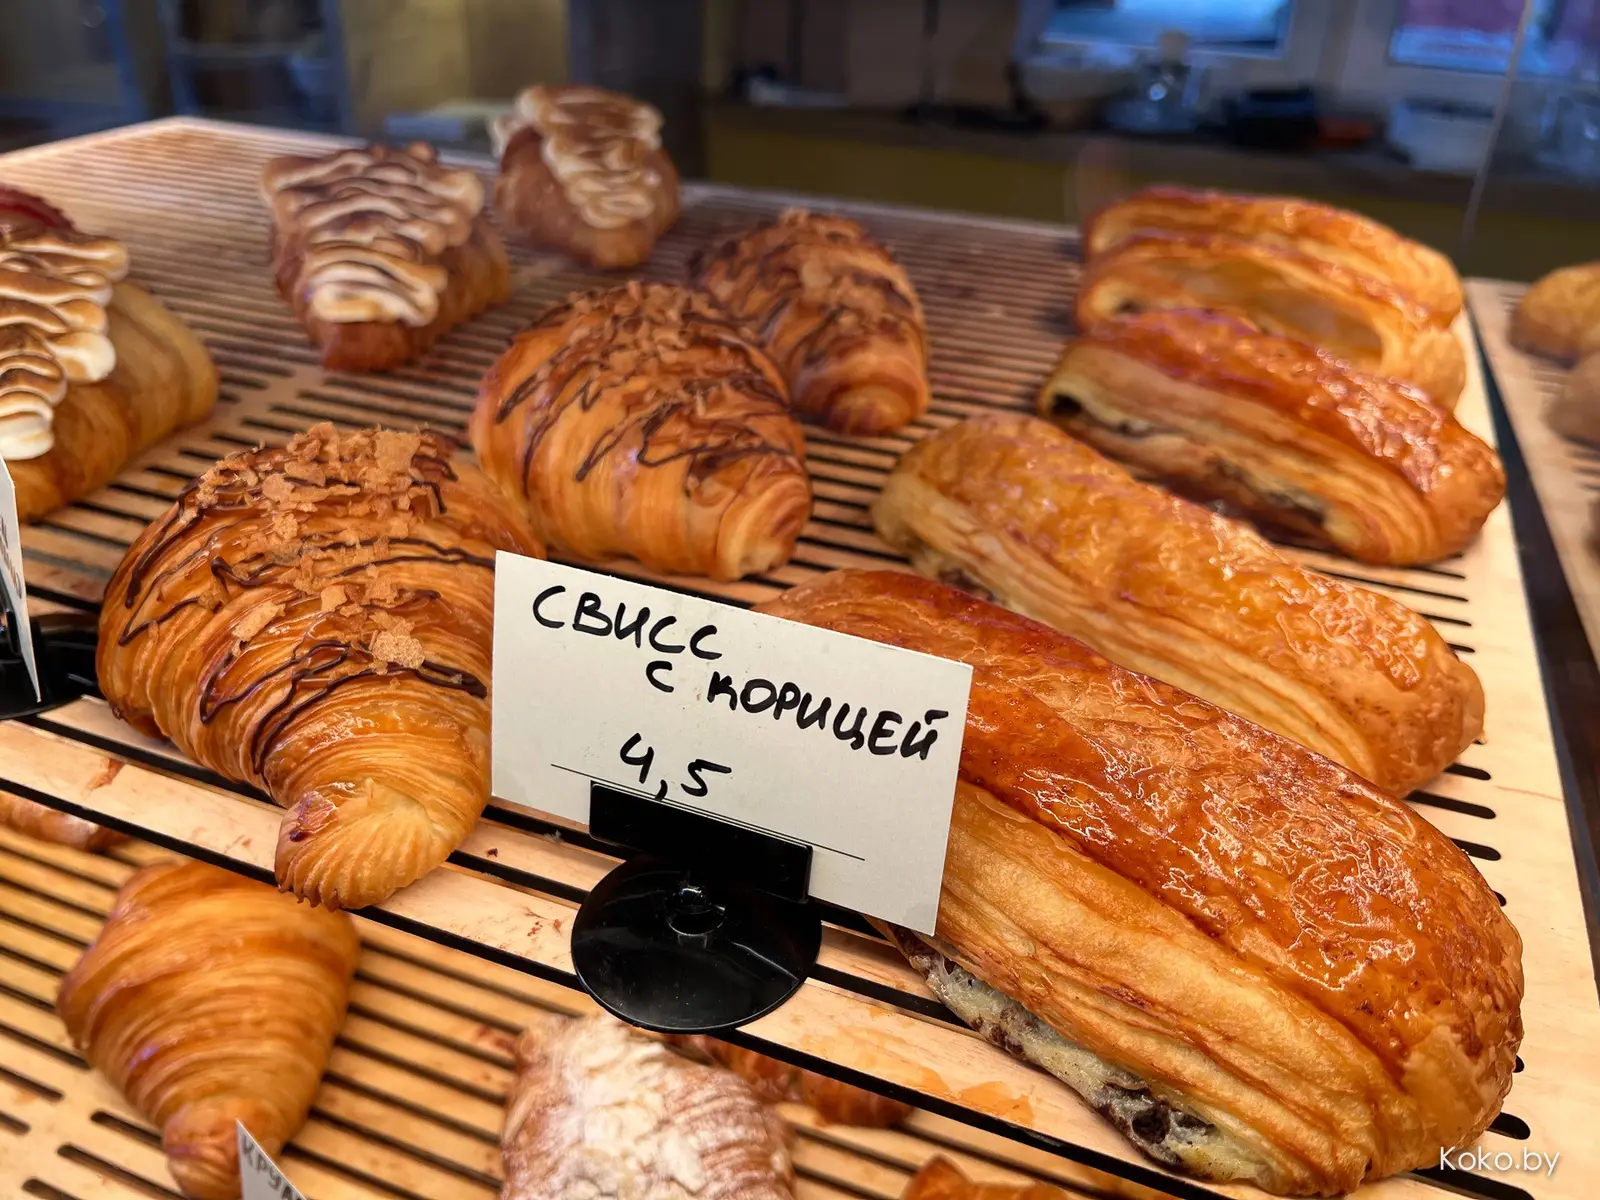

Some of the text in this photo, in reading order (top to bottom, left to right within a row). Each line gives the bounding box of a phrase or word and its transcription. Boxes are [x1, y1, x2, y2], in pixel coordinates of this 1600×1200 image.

[532, 585, 723, 660] СВИСС
[706, 671, 949, 761] КОРИЦЕЙ
[619, 732, 732, 801] 4,5
